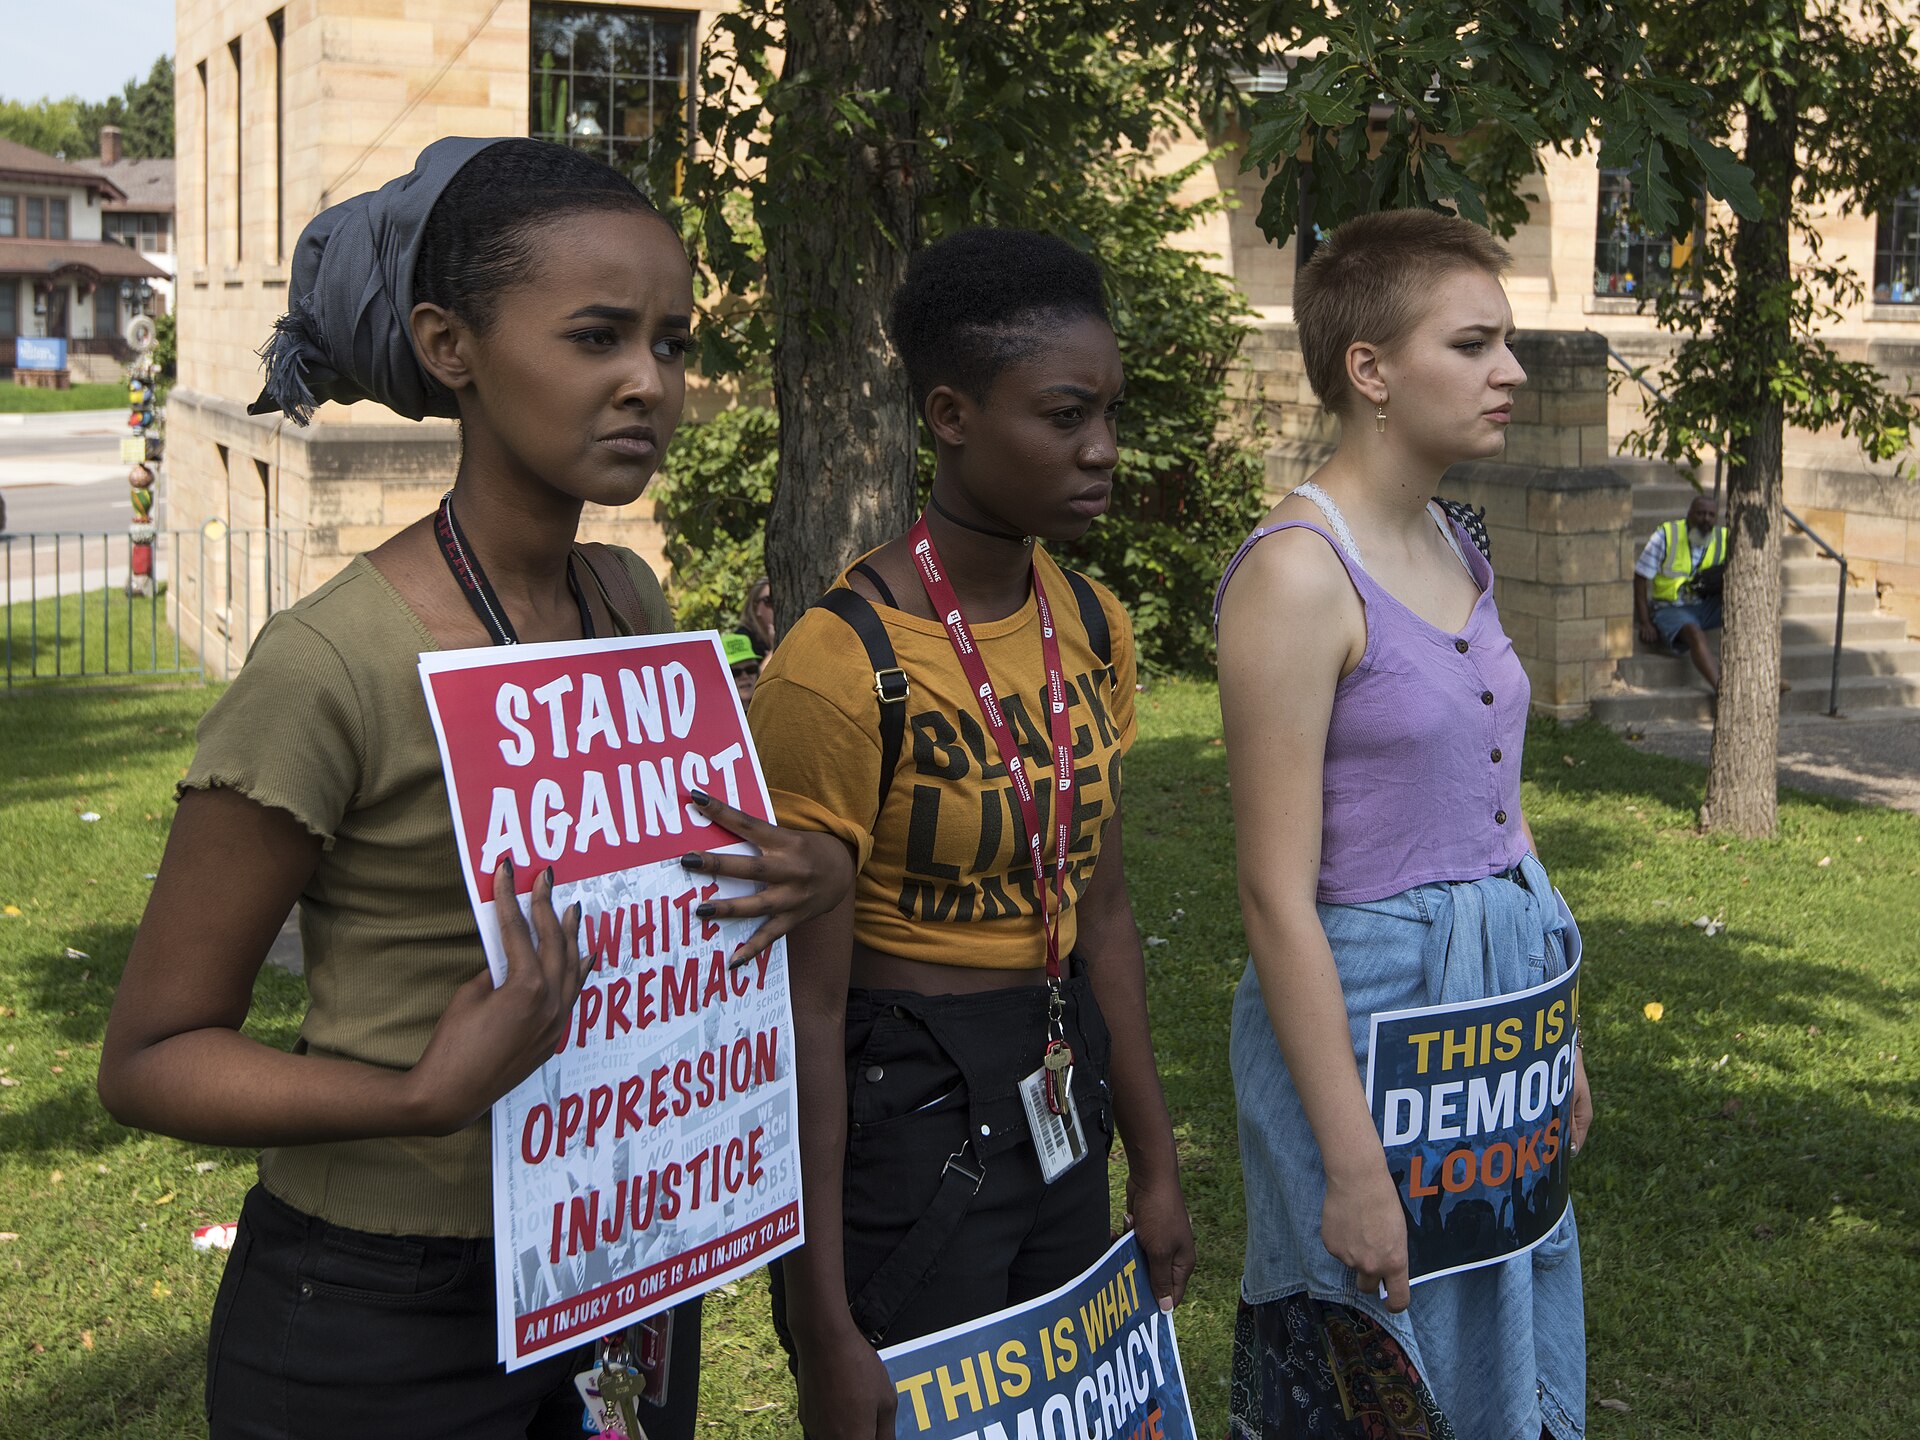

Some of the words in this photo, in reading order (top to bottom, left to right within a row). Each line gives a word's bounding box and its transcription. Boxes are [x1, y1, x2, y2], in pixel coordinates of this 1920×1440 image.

[923, 550, 942, 583] HAMLINE
[955, 621, 973, 654] HAMLINE
[495, 661, 696, 766] STAND
[987, 695, 1004, 727] HAMLINE
[1050, 669, 1059, 701] HAMLINE
[910, 664, 1120, 781] BLACK
[480, 742, 743, 874] AGAINST
[1016, 769, 1031, 801] HAMLINE
[585, 882, 721, 971] WHITE
[555, 941, 773, 1054] PREMACY
[758, 1004, 787, 1029] NOW
[602, 1053, 634, 1069] CITIZ
[605, 1035, 632, 1051] FIRST
[1408, 1017, 1522, 1074] THIS
[1534, 999, 1565, 1051] IS
[522, 1027, 777, 1165] OPPRESSION
[757, 1101, 774, 1123] WE
[759, 1141, 775, 1158] OR
[1409, 1117, 1561, 1198] LOOKS
[550, 1127, 765, 1264] INJUSTICE
[744, 1158, 787, 1205] JOBS
[745, 1202, 766, 1221] FOR
[770, 1188, 787, 1205] ALL
[523, 1319, 548, 1345] AN
[553, 1293, 611, 1335] INJURY
[616, 1281, 635, 1307] TO
[639, 1269, 668, 1299] ONE
[670, 1262, 684, 1285] IS
[687, 1253, 708, 1278] AN
[711, 1230, 757, 1269] INJURY
[759, 1221, 775, 1244] TO
[776, 1211, 797, 1237] ALL
[896, 1340, 1031, 1432] THIS
[1039, 1316, 1078, 1381] IS
[1080, 1259, 1140, 1354] WHAT
[951, 1312, 1165, 1440] OCRACY
